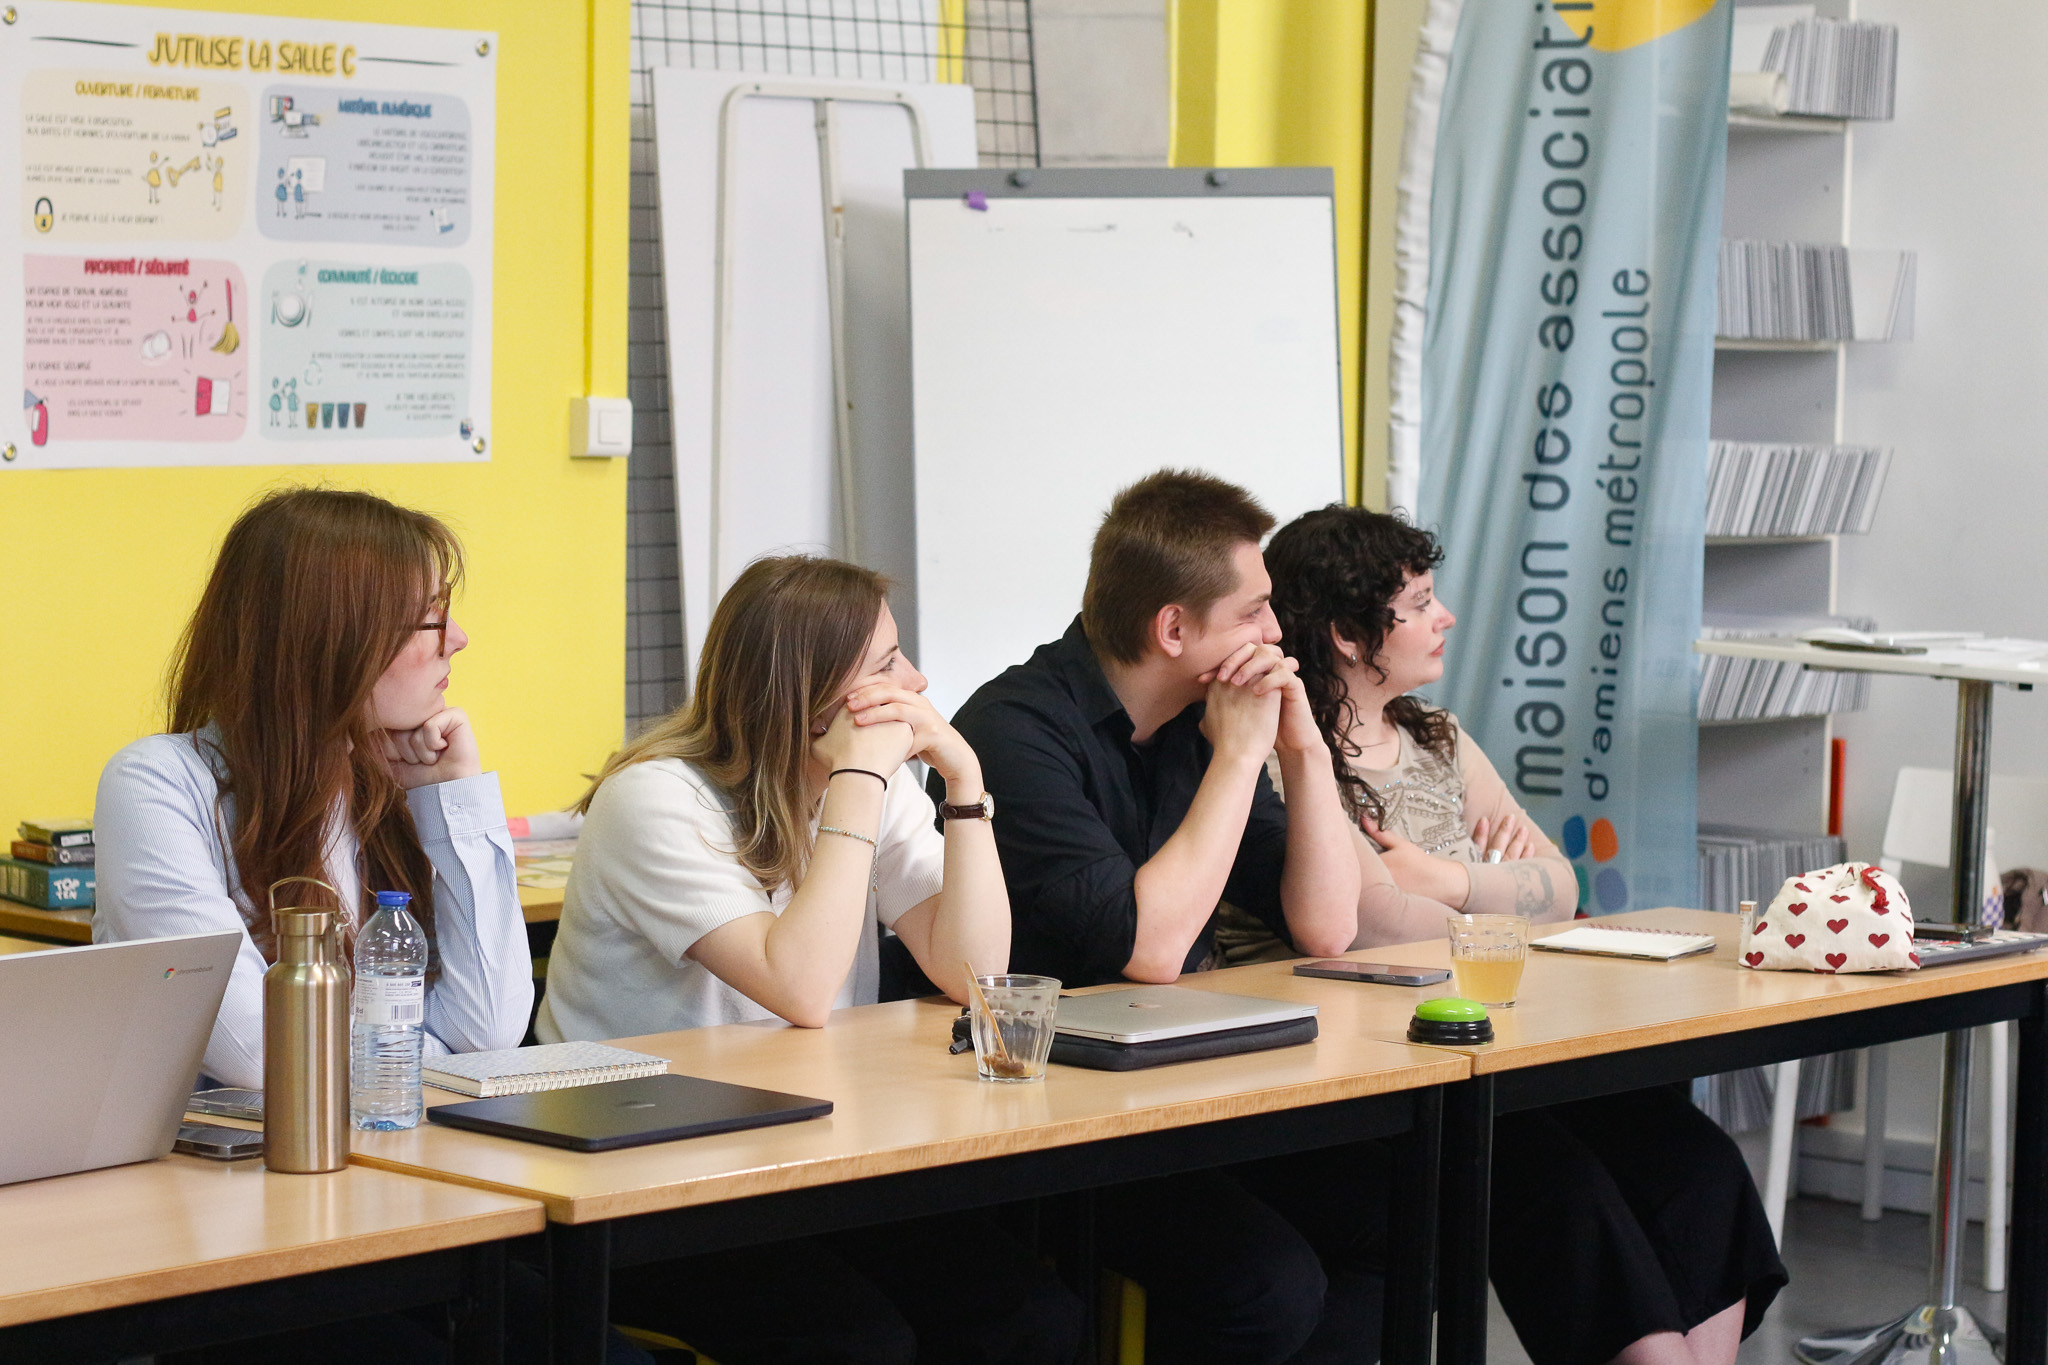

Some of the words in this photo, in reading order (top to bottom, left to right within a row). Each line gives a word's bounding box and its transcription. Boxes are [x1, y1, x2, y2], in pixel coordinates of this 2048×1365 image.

[249, 39, 272, 70] LA
[277, 42, 337, 75] SALLE
[341, 47, 355, 77] C
[75, 80, 134, 98] OUVERTURE
[143, 84, 200, 102] FERMETURE
[145, 257, 189, 276] SÉCURITÉ
[1596, 268, 1655, 546] métropole
[1522, 381, 1573, 512] des
[1502, 541, 1570, 797] maison
[1583, 566, 1629, 801] d'amiens
[54, 878, 80, 891] TOP
[56, 889, 77, 900] TEN
